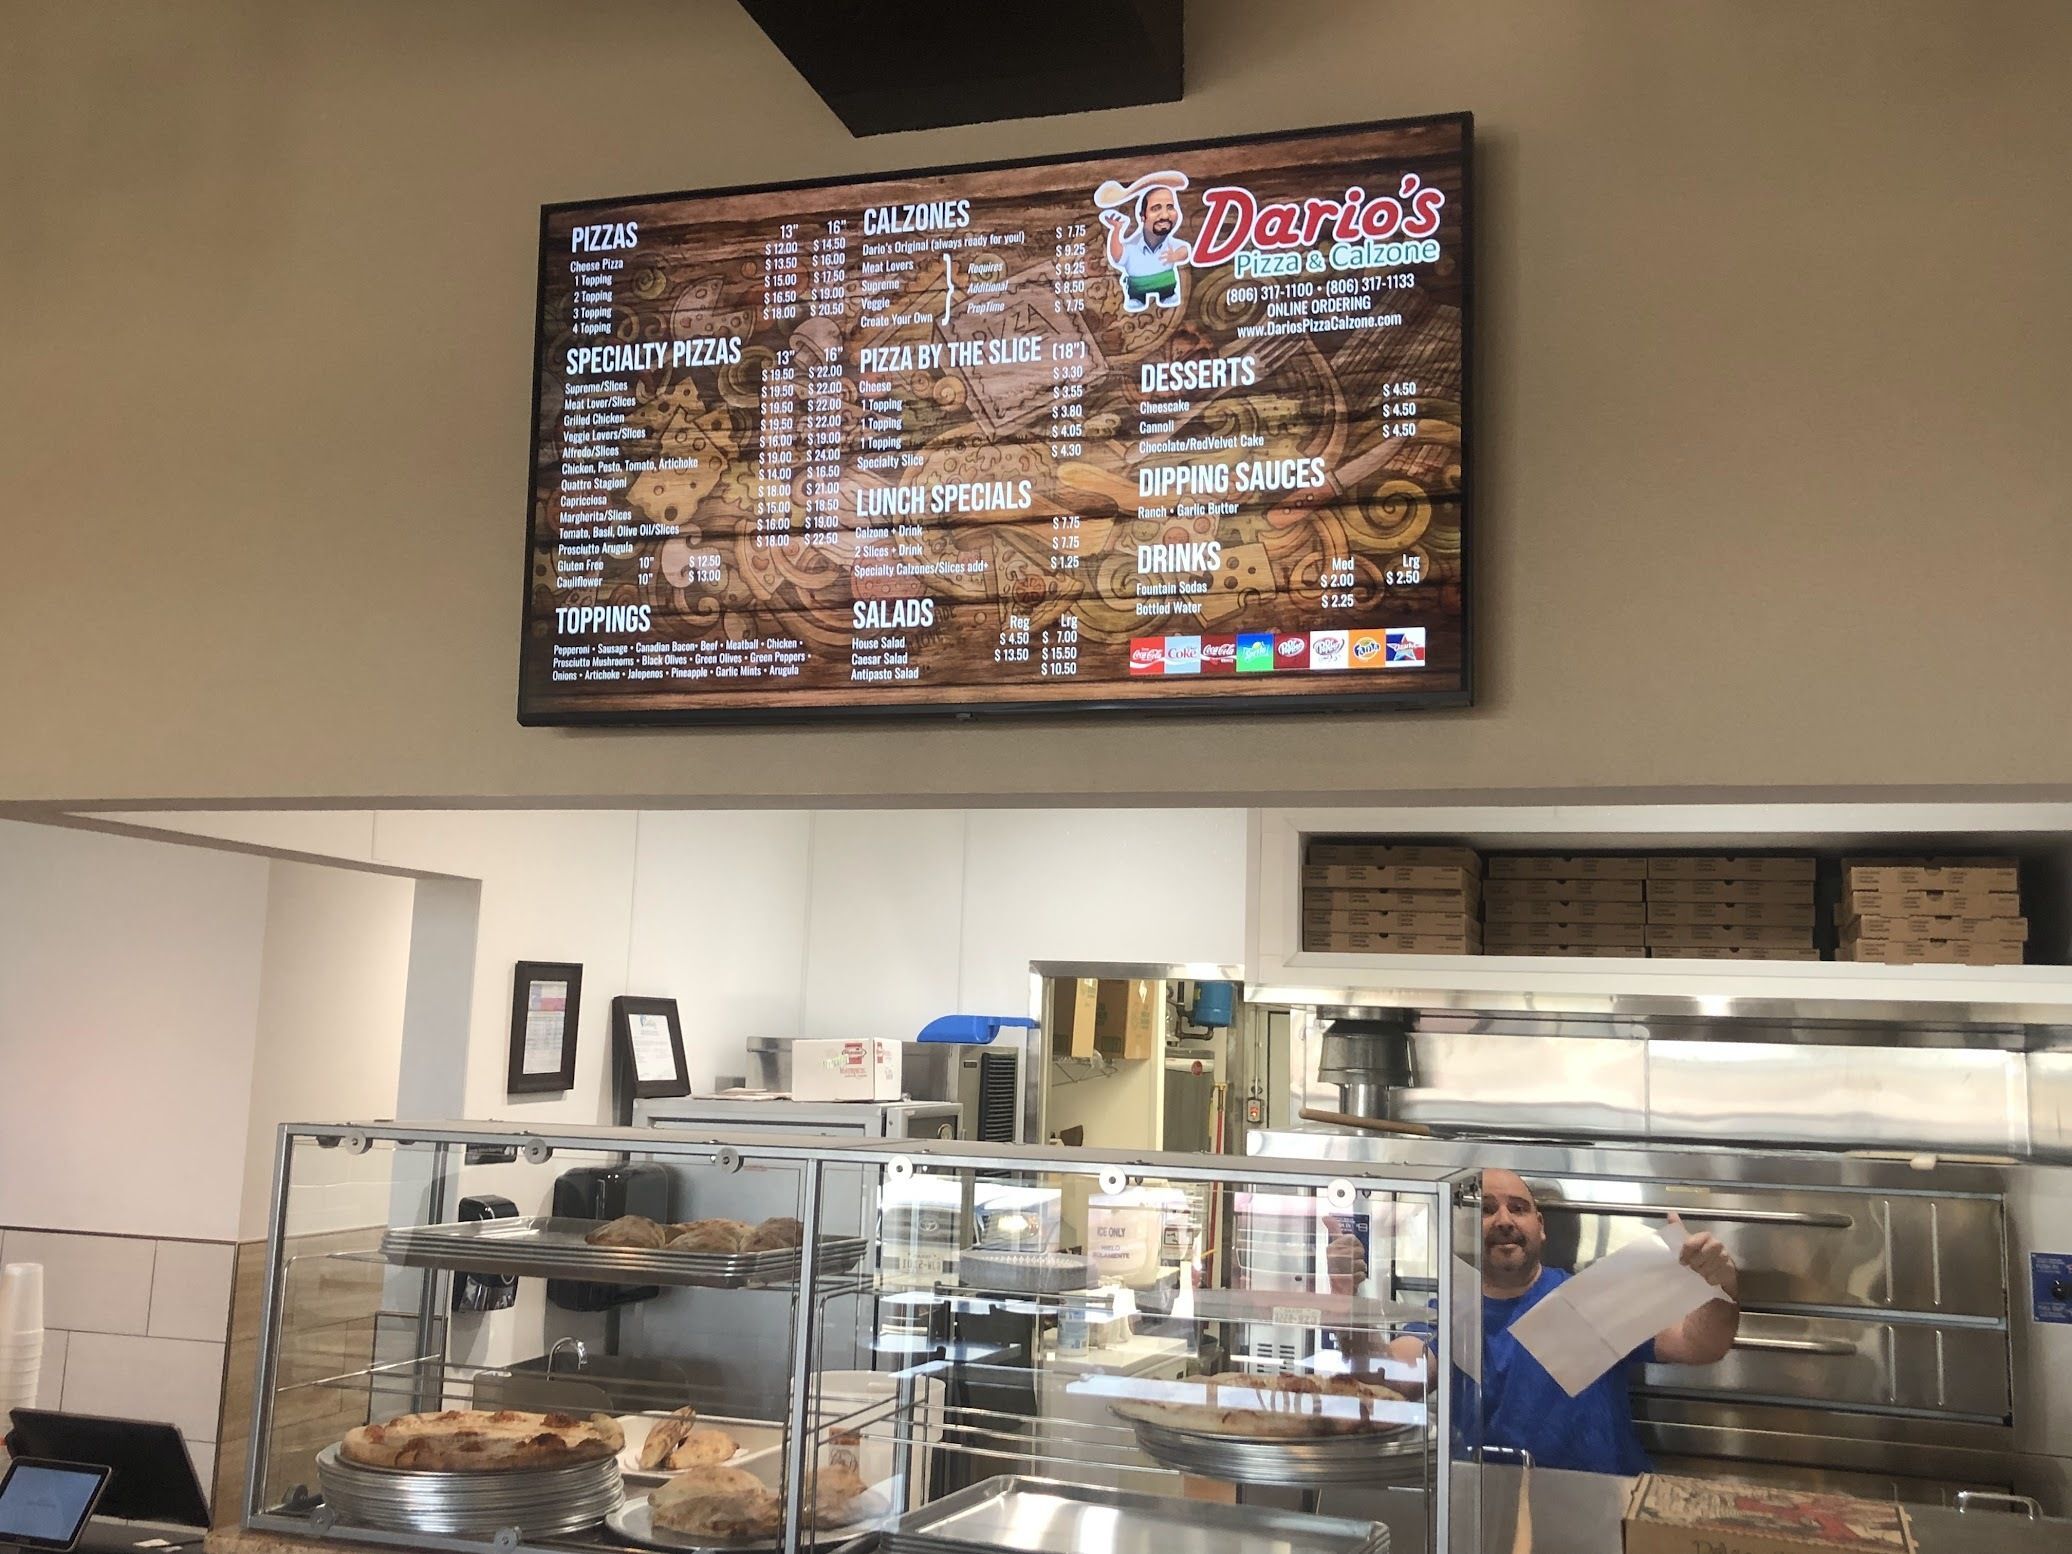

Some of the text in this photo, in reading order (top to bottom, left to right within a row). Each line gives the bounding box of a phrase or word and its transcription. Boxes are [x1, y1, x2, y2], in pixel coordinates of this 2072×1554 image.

[864, 200, 970, 235] CALZONES
[1190, 173, 1445, 268] Dario's
[572, 222, 638, 252] PIZZAS
[862, 243, 892, 256] Dario's
[894, 241, 928, 255] Original
[931, 238, 962, 252] (always
[964, 236, 988, 248] ready
[990, 234, 1001, 245] for
[1234, 238, 1441, 278] Pizza & Calzone
[570, 258, 623, 273] Cheese Pizza
[862, 259, 914, 273] Meat Lovers
[581, 274, 612, 286] Topping
[862, 280, 899, 293] Supreme
[574, 290, 612, 302] 2 Topping
[1226, 274, 1414, 305] (806) 317-1100 (806) 317-1133
[862, 299, 890, 310] Veggie
[1267, 295, 1371, 317] ONLINE ORDERING
[573, 306, 612, 319] 3 Topping
[861, 312, 933, 328] Create Your Own
[1237, 313, 1402, 338] www.DariosPizzaCalzone.com
[572, 322, 611, 334] 4 Topping
[566, 336, 741, 375] SPECIALTY PIZZAS
[860, 346, 912, 374] PIZZA
[918, 344, 942, 370] BY
[947, 340, 983, 367] THE
[989, 336, 1042, 364] SLICE
[1141, 356, 1256, 393] DESSERTS
[859, 381, 891, 393] Cheese
[564, 399, 584, 410] Meat
[867, 399, 902, 411] Topping
[564, 412, 624, 426] Grilled Chicken
[867, 418, 902, 431] Topping
[1139, 421, 1174, 435] Cannoli
[563, 430, 590, 444] Veggie
[867, 437, 901, 450] Topping
[1240, 435, 1264, 447] Cake
[562, 457, 698, 476] Chicken, Pesto, Tomato, Artichoke
[857, 454, 924, 470] Specialty Slice
[561, 477, 627, 491] Quattro Stagioni
[1139, 457, 1325, 497] DIPPING SAUCES
[560, 495, 607, 508] Capricciosa
[856, 480, 1032, 517] LUNCH SPECIALS
[1138, 502, 1239, 519] Ranch Garlic Butter
[559, 528, 591, 540] Tomato,
[593, 526, 615, 539] Basil,
[617, 526, 638, 536] Olive
[855, 525, 922, 538] Calzone Drink
[558, 542, 633, 556] Prosciutto Arugula
[855, 544, 923, 557] 2 Slices Drink
[1137, 541, 1221, 574] DRINKS
[1332, 557, 1354, 571] Med
[1403, 554, 1420, 569] Lrg
[558, 560, 584, 572] Gluten
[586, 559, 604, 570] Free
[854, 565, 894, 577] Specialty
[556, 576, 602, 588] Cauliflower
[1136, 582, 1207, 596] Fountain Sodas
[853, 598, 934, 629] SALADS
[1135, 601, 1202, 616] Bottled Water
[556, 604, 650, 634] TOPPINGS
[1010, 615, 1030, 630] Reg
[1061, 614, 1078, 629] Lrg
[554, 644, 590, 656] Pepperoni
[598, 643, 628, 654] Sausage
[636, 642, 670, 652] Canadian
[701, 640, 718, 650] Beef
[726, 638, 758, 650] Meatball
[766, 638, 796, 648] Chicken
[852, 637, 905, 650] House Salad
[553, 651, 805, 668] Prosciutto Mushrooms Black Olives Green Olives Green Peppers
[851, 652, 907, 665] Caesar Salad
[552, 670, 577, 680] Onions
[584, 668, 620, 680] Artichoke
[671, 666, 708, 679] Pineapple
[716, 666, 738, 677] Garlic
[770, 665, 799, 678] Arugula
[851, 667, 918, 682] Antipasto Salad
[1097, 1227, 1125, 1237] ICE ONLY
